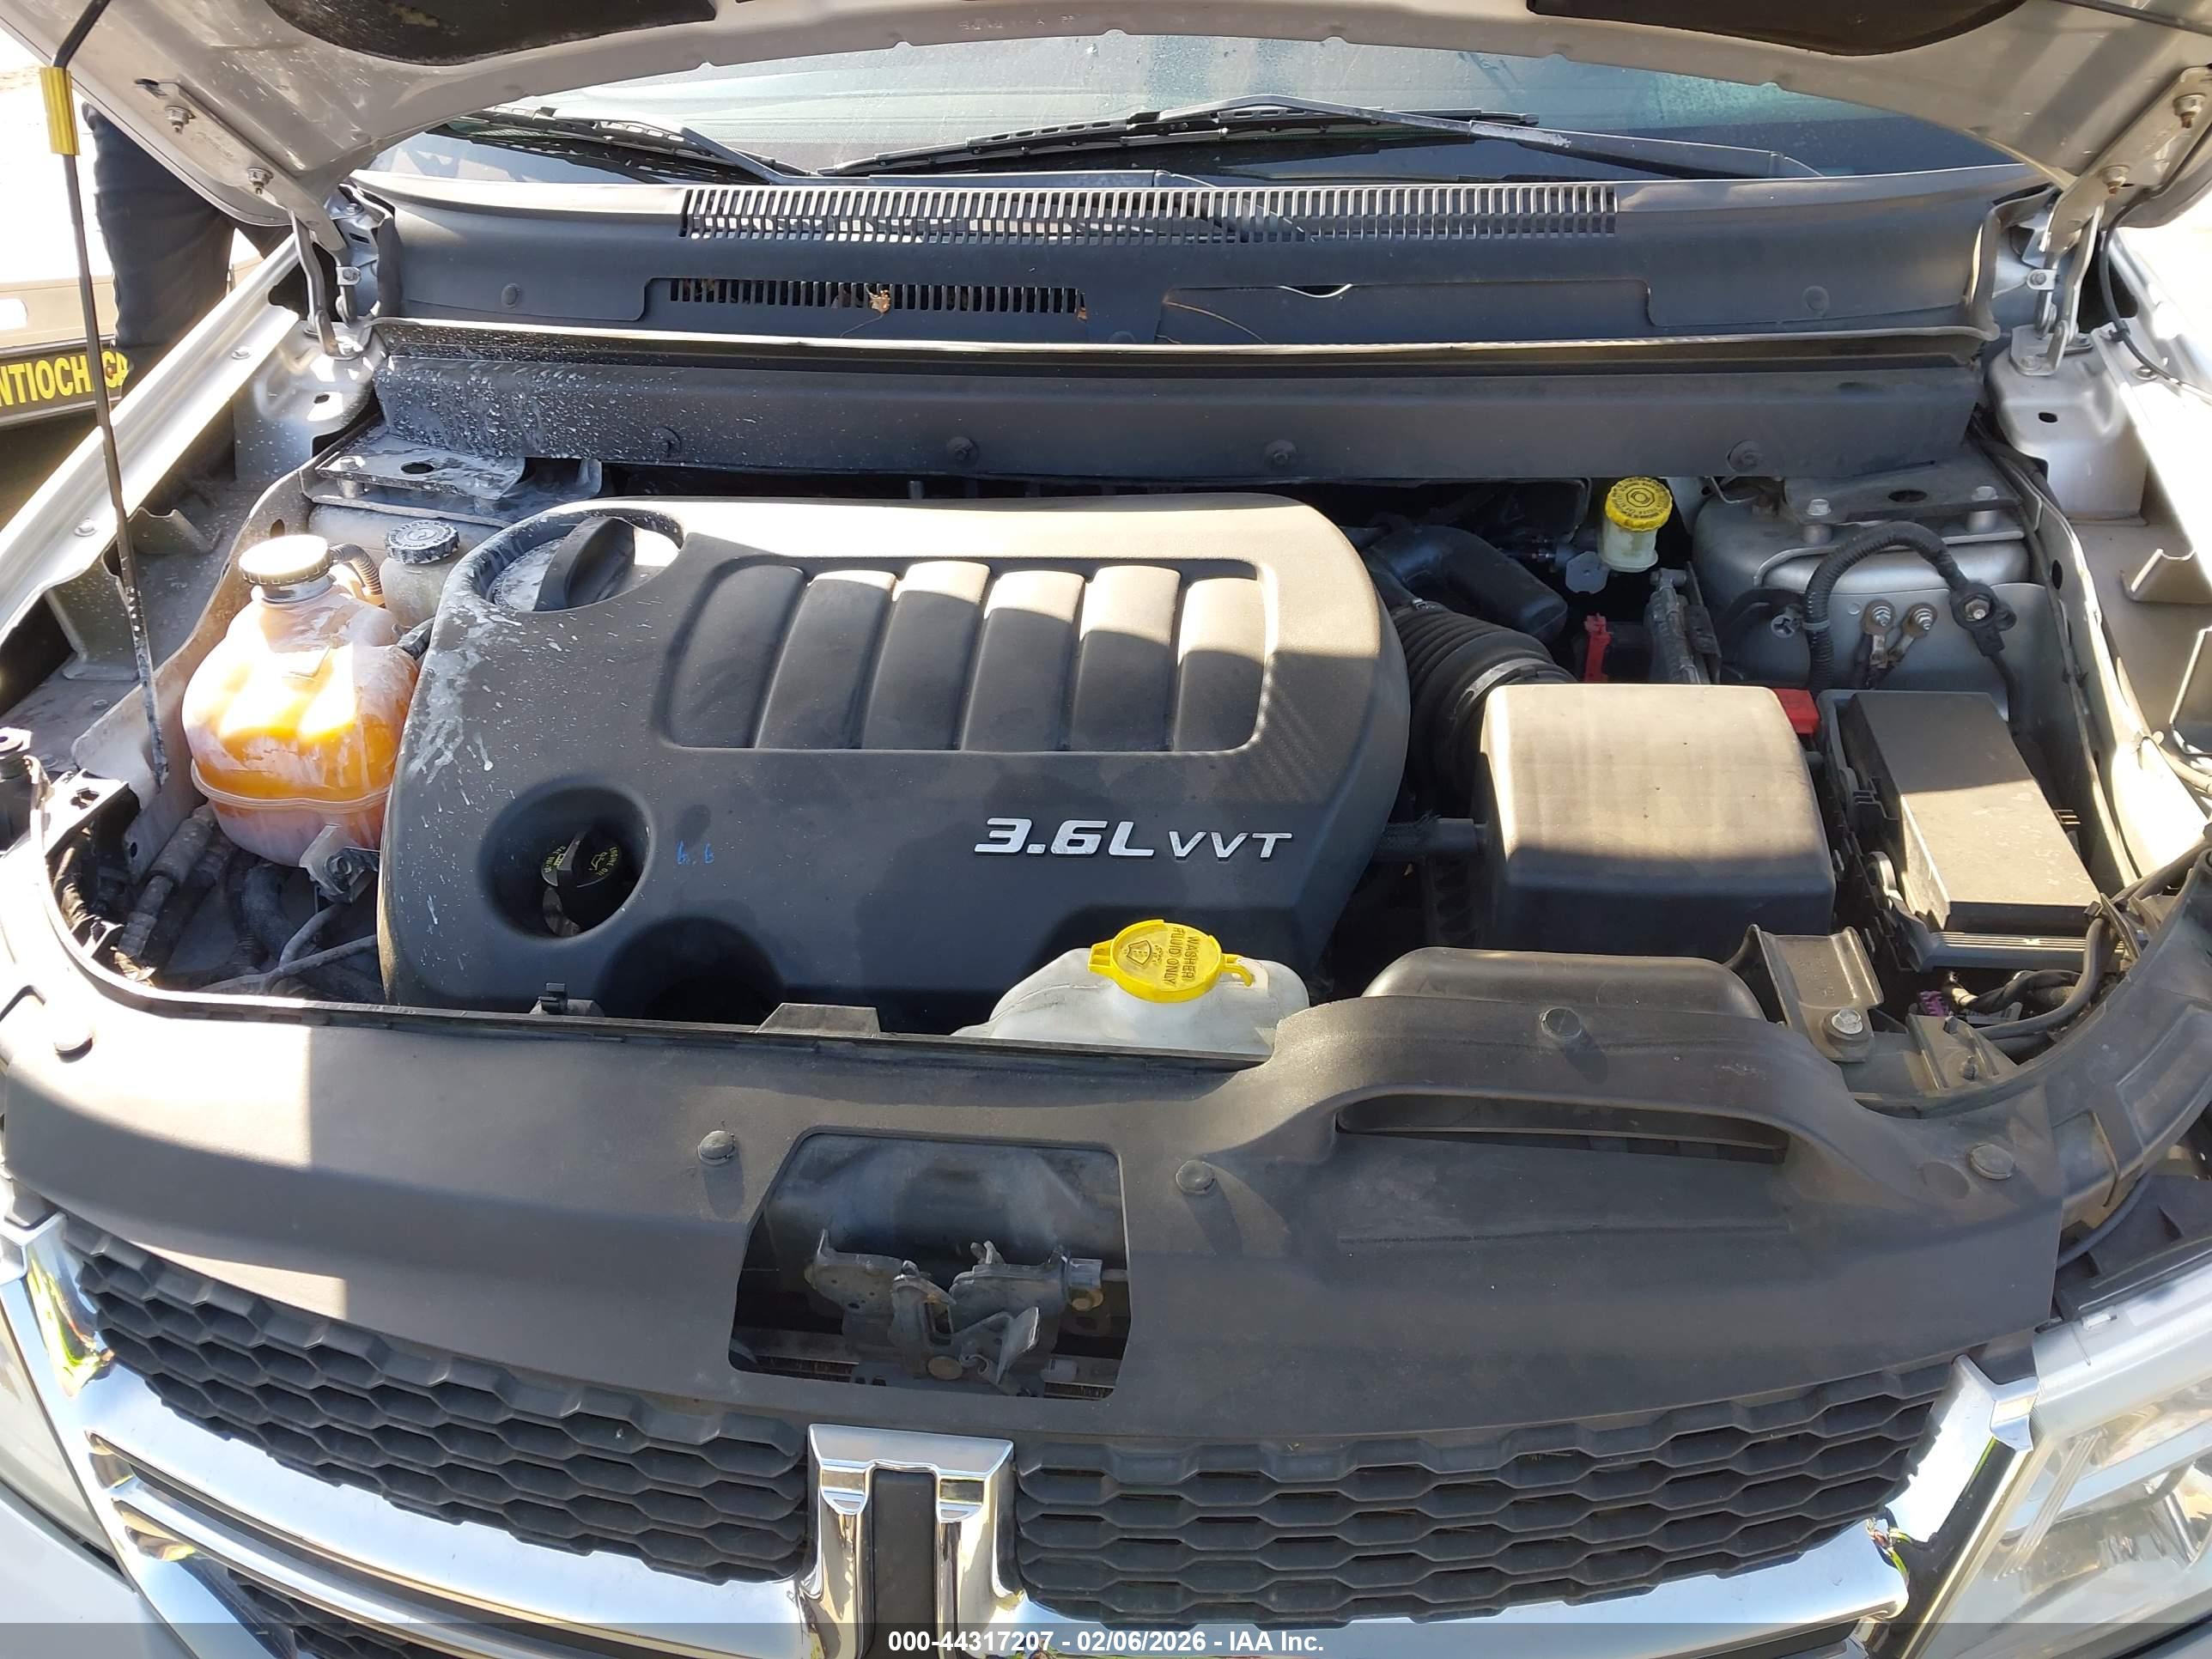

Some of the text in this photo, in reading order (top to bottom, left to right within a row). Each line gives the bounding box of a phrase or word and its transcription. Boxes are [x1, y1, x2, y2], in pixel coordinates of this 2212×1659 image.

[974, 817, 1292, 860] 3.6L VVT
[1162, 927, 1185, 986] FLUID ONLY
[1181, 936, 1200, 979] WASHER
